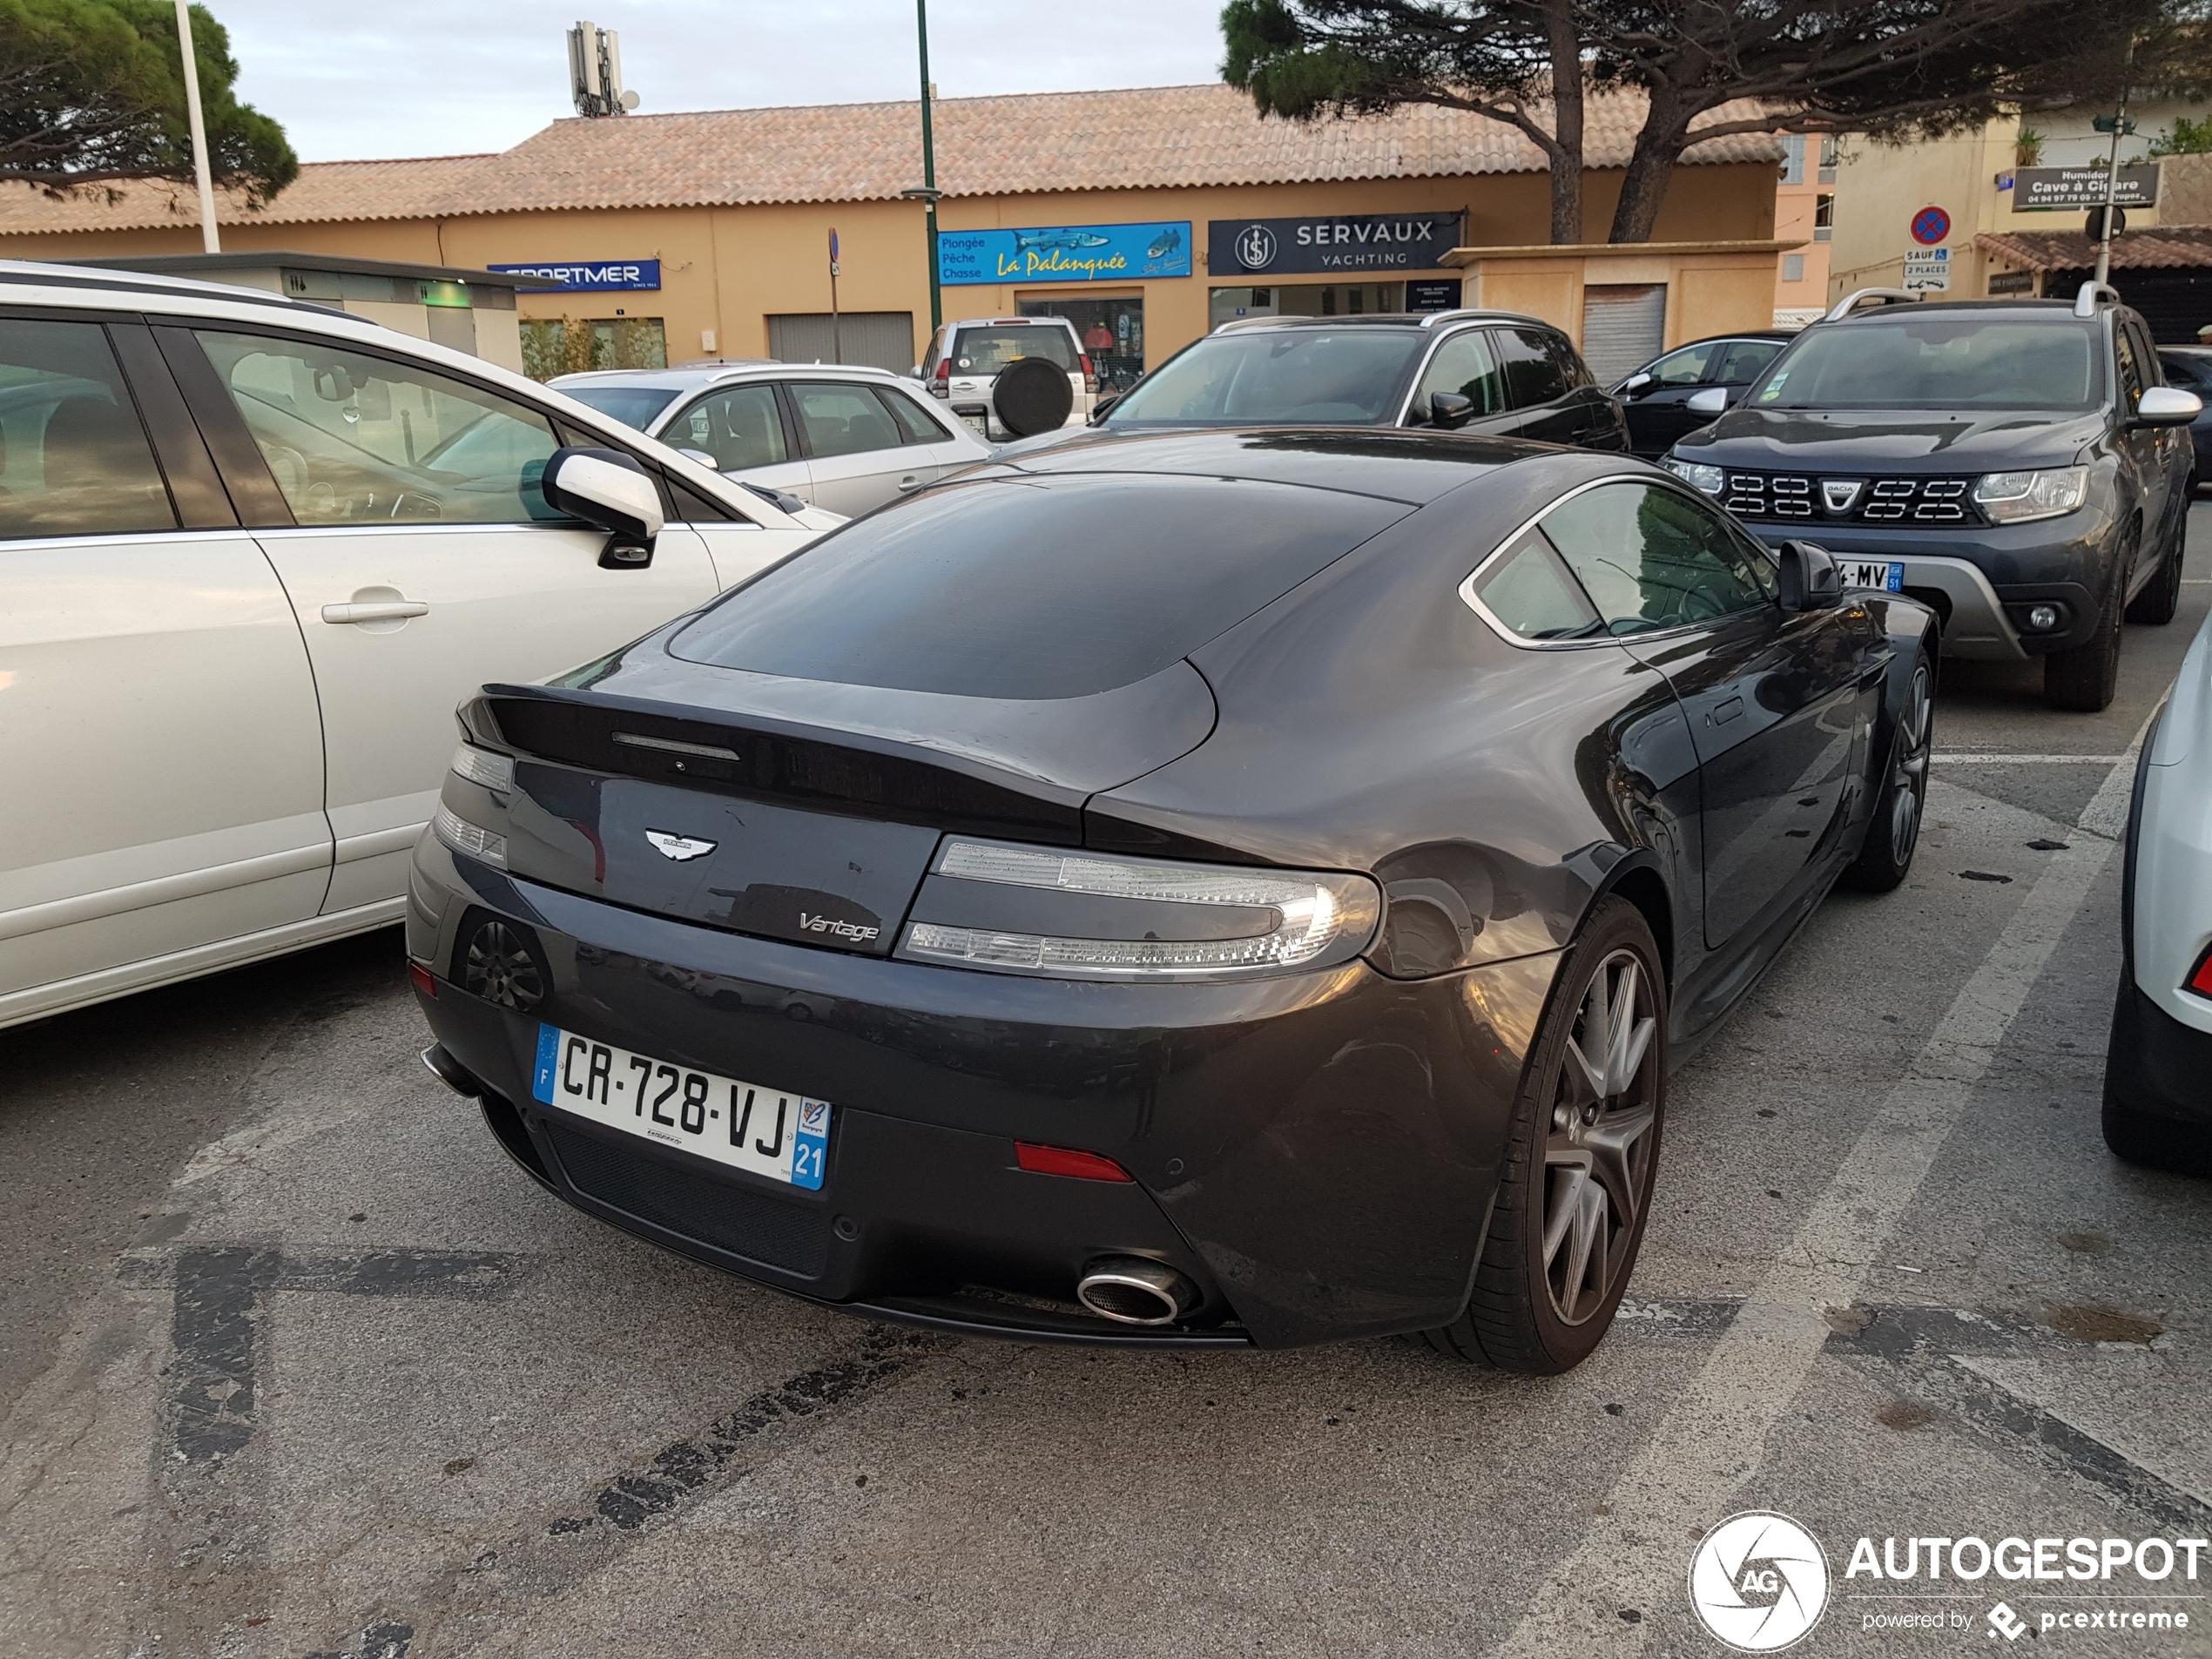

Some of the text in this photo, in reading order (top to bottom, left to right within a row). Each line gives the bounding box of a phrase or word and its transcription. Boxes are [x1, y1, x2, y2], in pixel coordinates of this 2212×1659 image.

[2032, 181, 2069, 193] Cave
[2074, 179, 2083, 192] à
[1297, 221, 1433, 246] SERVAUX
[942, 237, 985, 251] Plongée
[943, 253, 975, 264] Pêche
[1322, 253, 1407, 266] YACHTING
[1907, 251, 1933, 260] SAUF
[997, 249, 1128, 280] La Palanquée
[1908, 265, 1913, 273] 2
[943, 268, 982, 279] Chasse
[1889, 578, 1899, 589] 51
[800, 913, 880, 942] Vantage
[540, 1069, 549, 1085] F
[563, 1036, 787, 1158] CR-728-VJ
[802, 1123, 823, 1133] Bourgogne
[795, 1143, 822, 1178] 21
